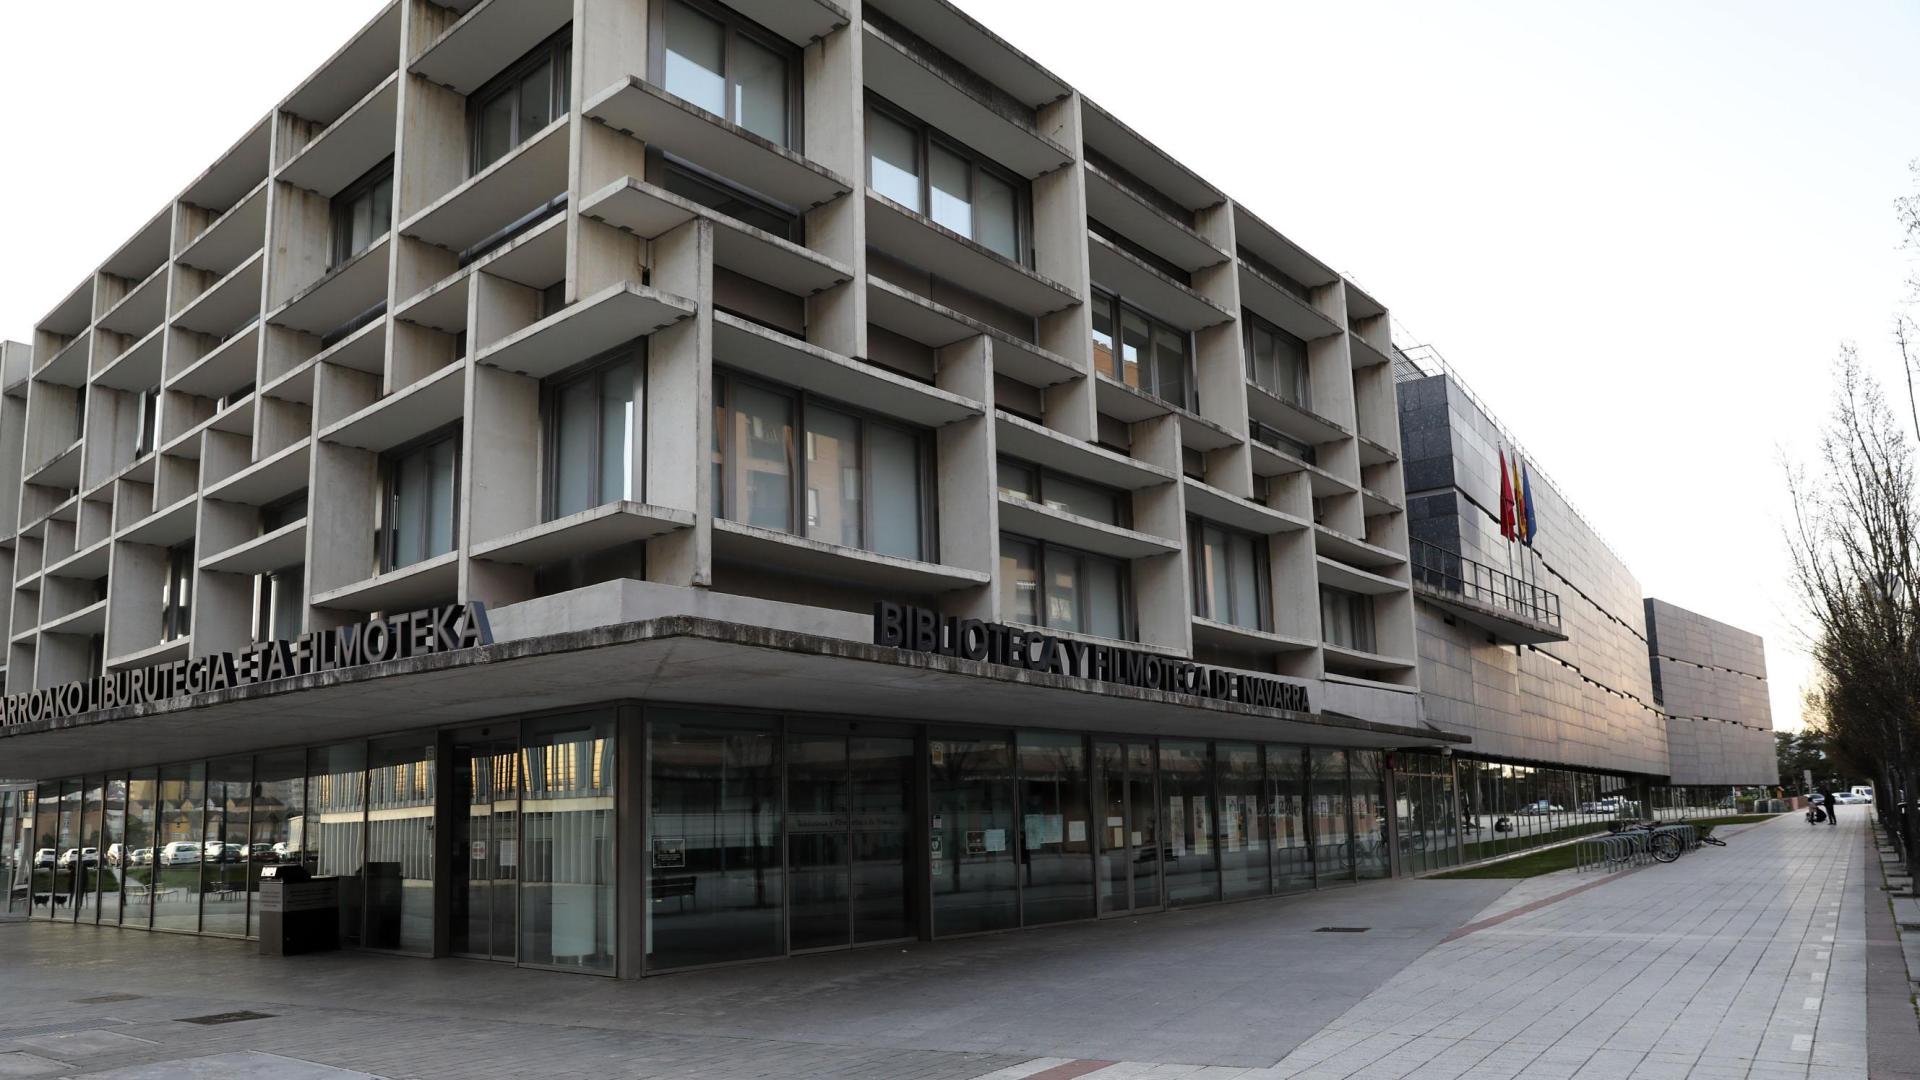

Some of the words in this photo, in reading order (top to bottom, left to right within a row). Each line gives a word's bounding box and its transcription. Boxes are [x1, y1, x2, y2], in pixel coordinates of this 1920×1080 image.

[0, 680, 83, 727] ARROAKO
[88, 652, 233, 711] LIBURUTEGIA
[237, 640, 290, 686] ETA
[296, 601, 491, 675] FILMOTEKA
[876, 600, 1064, 675] BIBLIOTECA
[1066, 639, 1089, 677] Y
[1091, 645, 1210, 698] FILMOTECA
[1212, 669, 1239, 703] DE
[1242, 675, 1310, 713] NAVARRA
